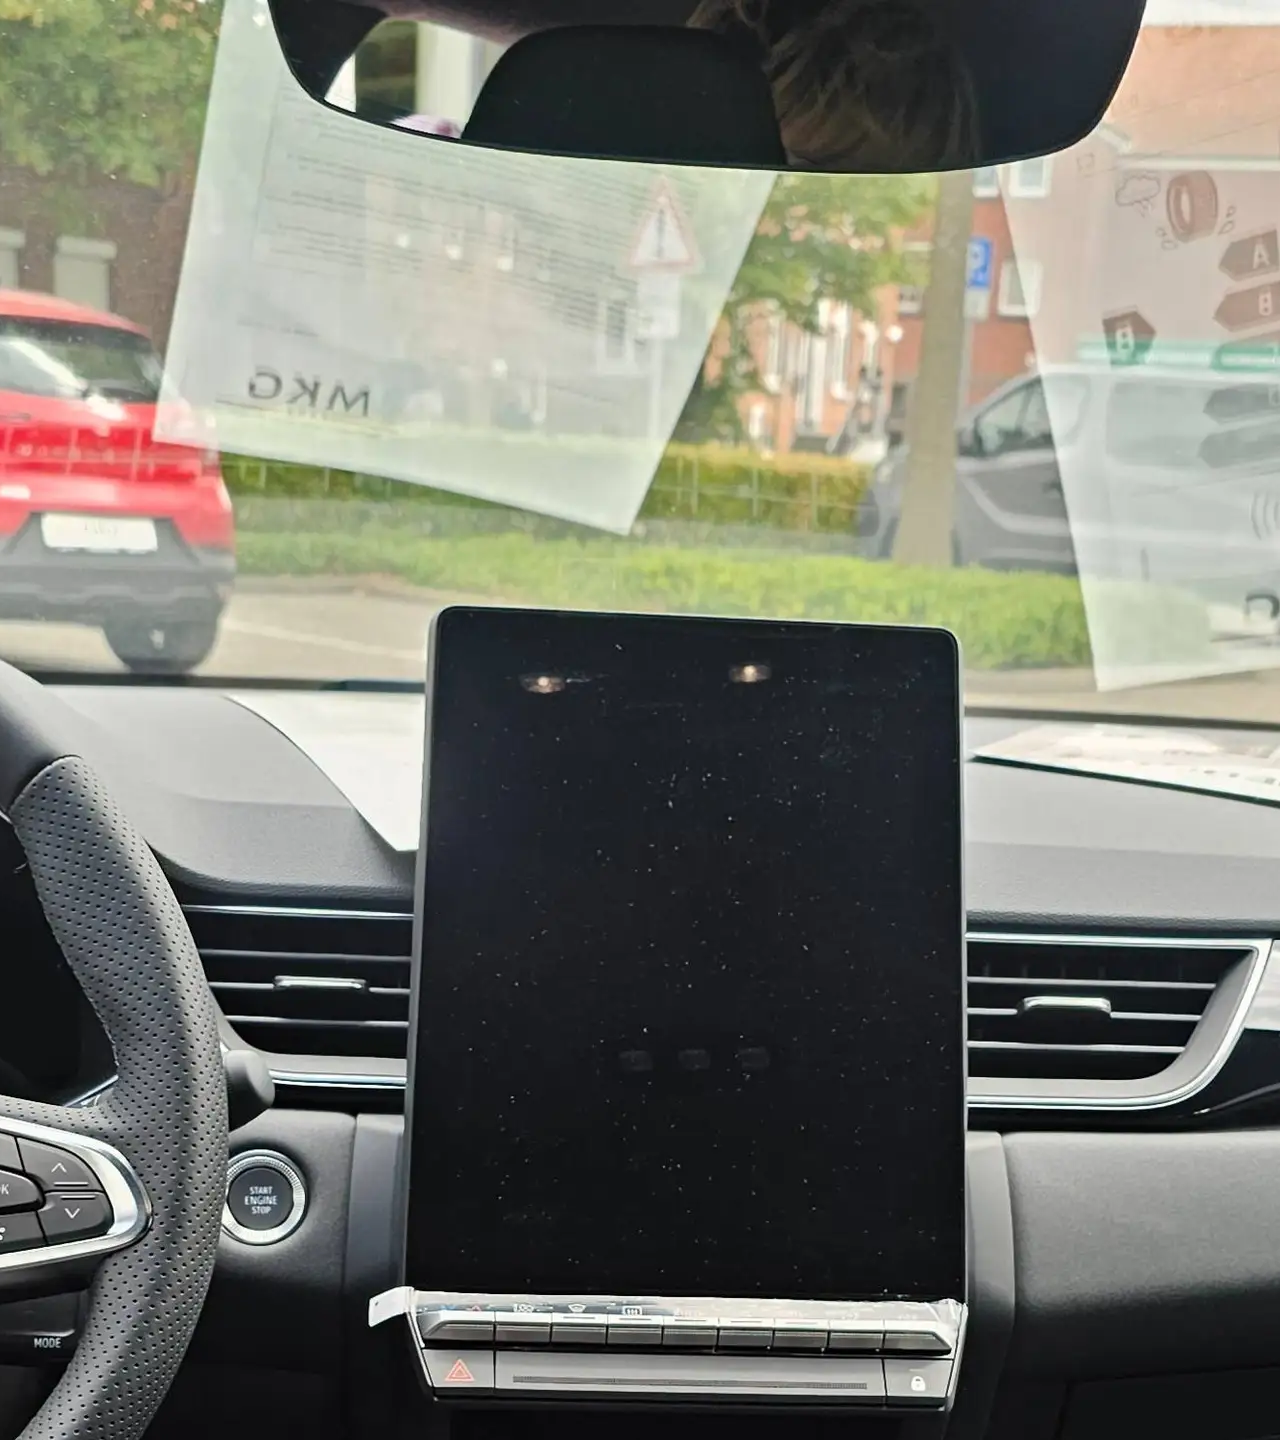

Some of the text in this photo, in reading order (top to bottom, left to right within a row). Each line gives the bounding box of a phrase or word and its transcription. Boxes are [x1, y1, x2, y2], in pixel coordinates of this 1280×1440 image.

[249, 1186, 273, 1196] START
[244, 1195, 278, 1206] ENGINE
[251, 1206, 272, 1216] STOP
[33, 1337, 62, 1350] MODE
